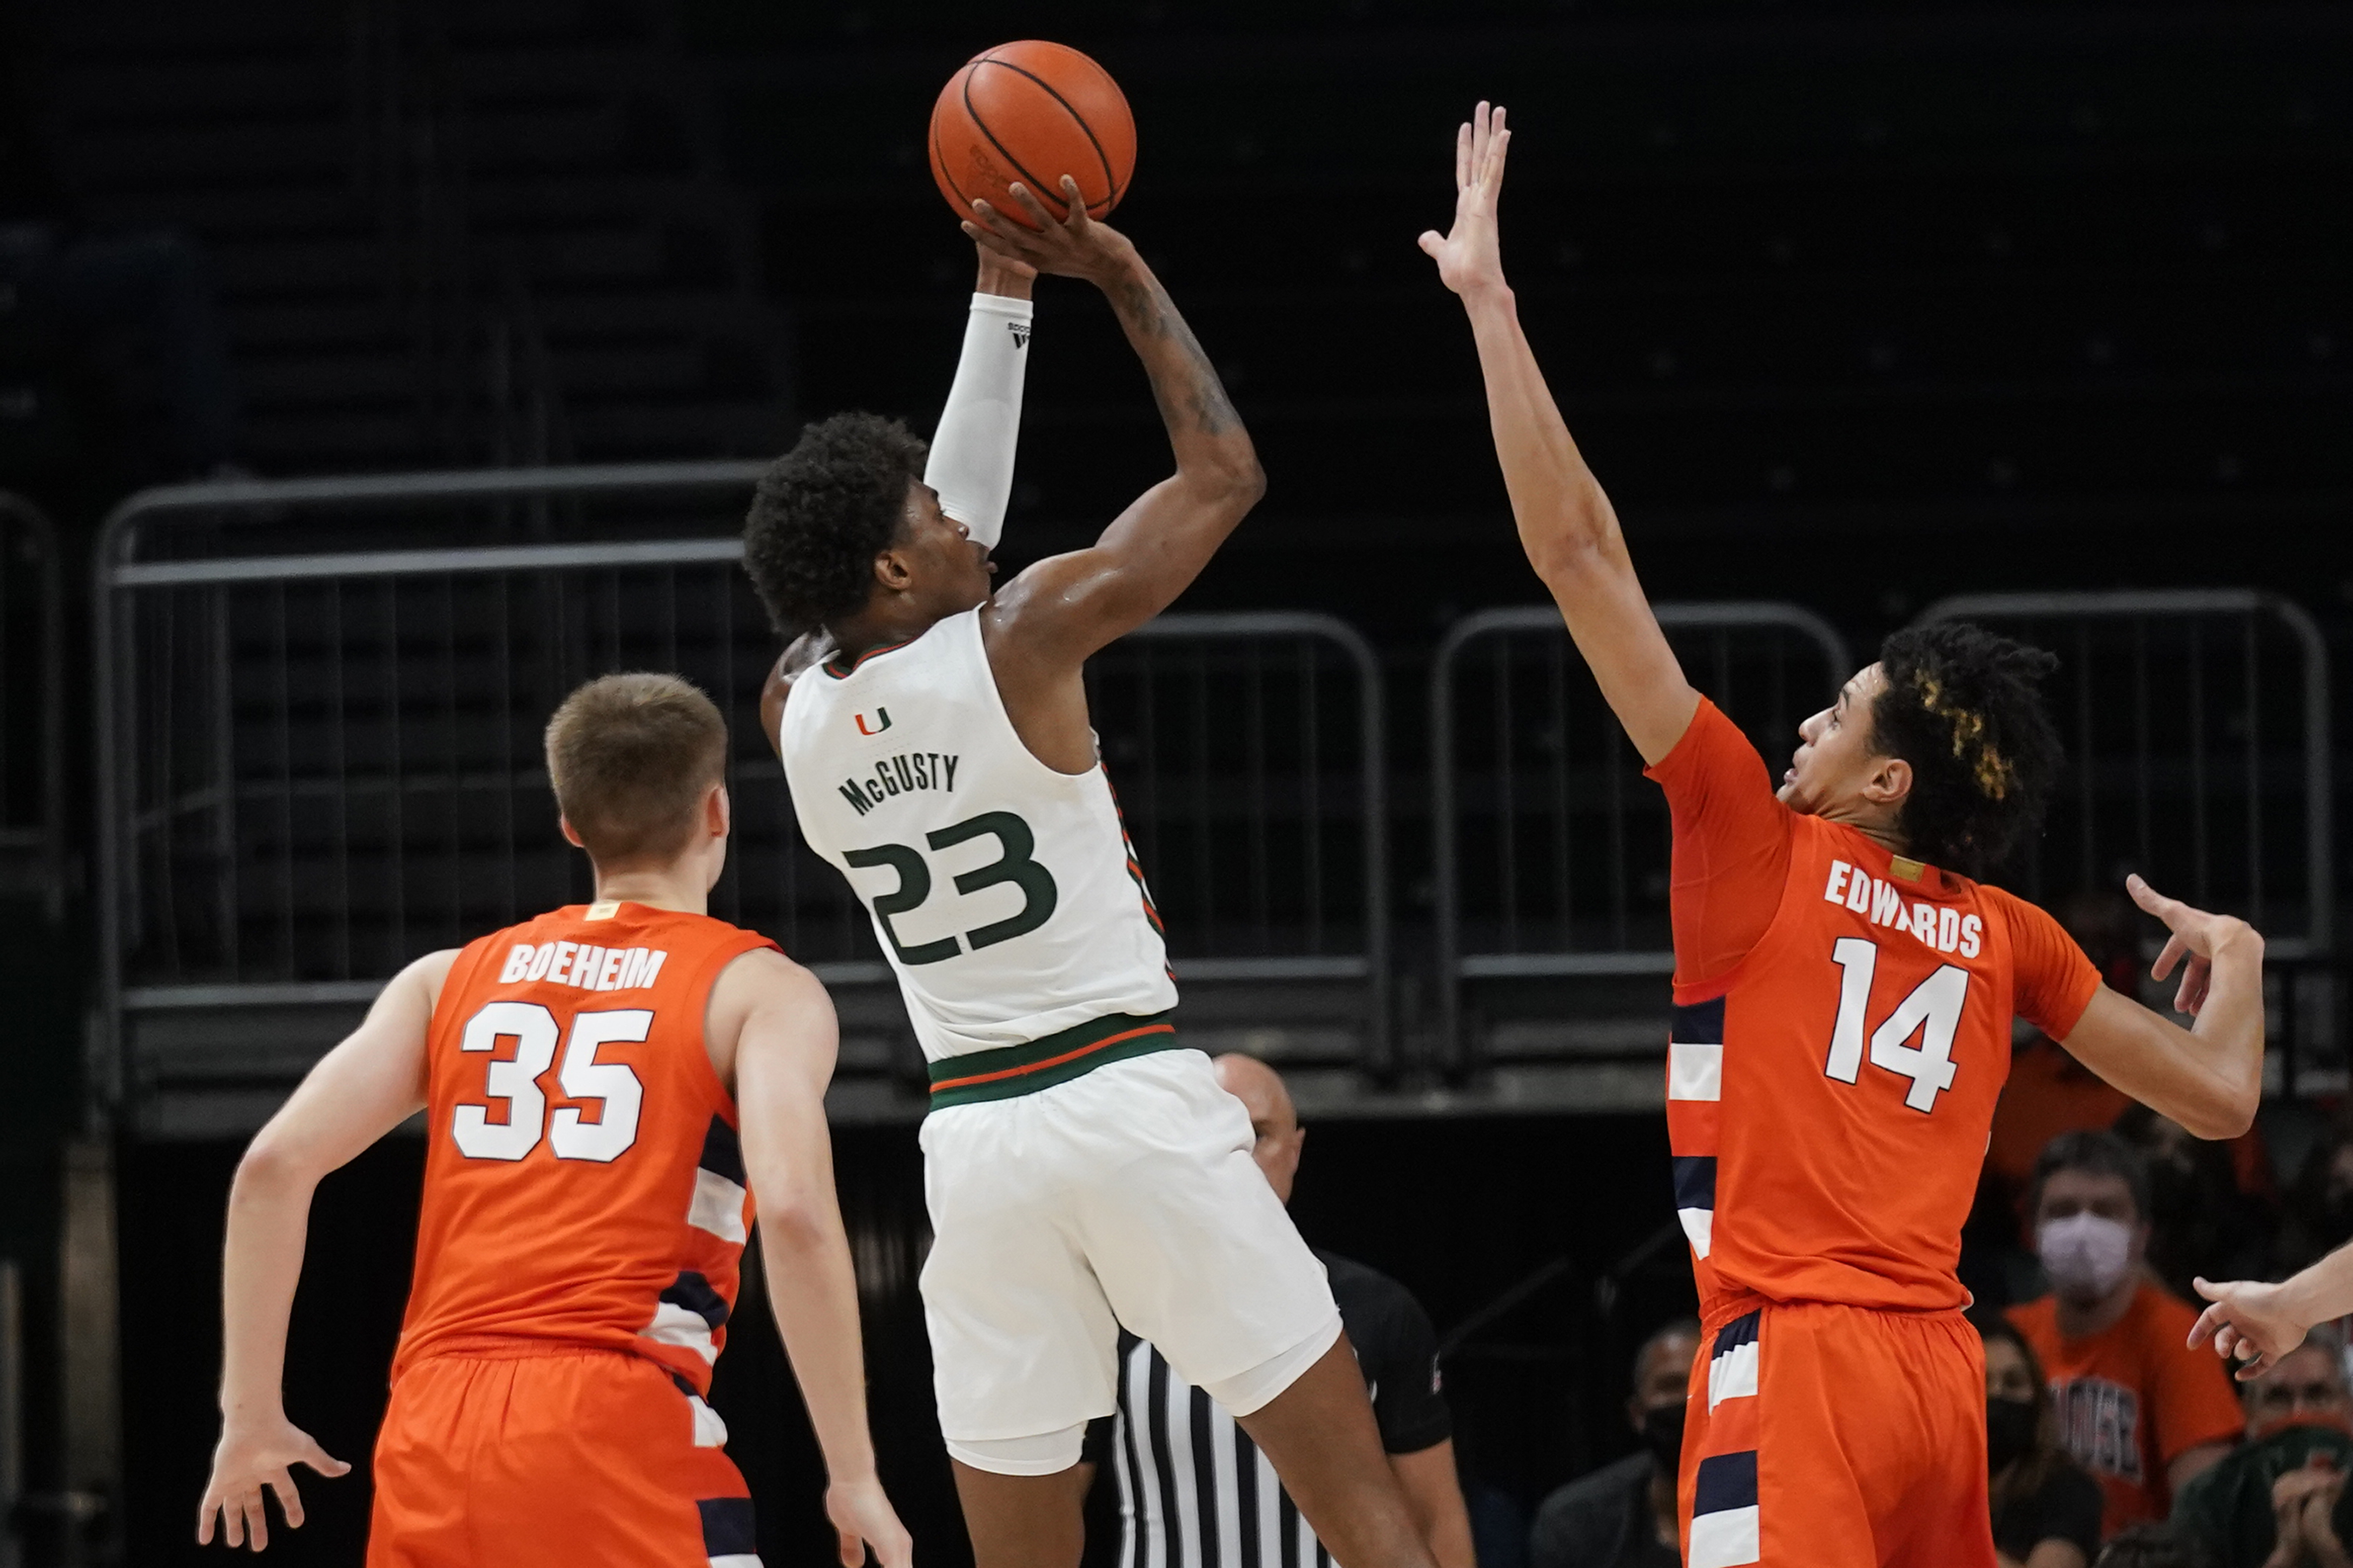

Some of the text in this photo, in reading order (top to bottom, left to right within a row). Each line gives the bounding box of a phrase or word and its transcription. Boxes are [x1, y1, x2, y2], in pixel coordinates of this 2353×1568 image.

[837, 752, 959, 816] McGUSTY
[841, 811, 1057, 966] 23
[1824, 859, 1982, 959] EDWARDS
[499, 940, 668, 991] BOEHEIM
[1824, 936, 1970, 1114] 14
[451, 1001, 655, 1163] 35
